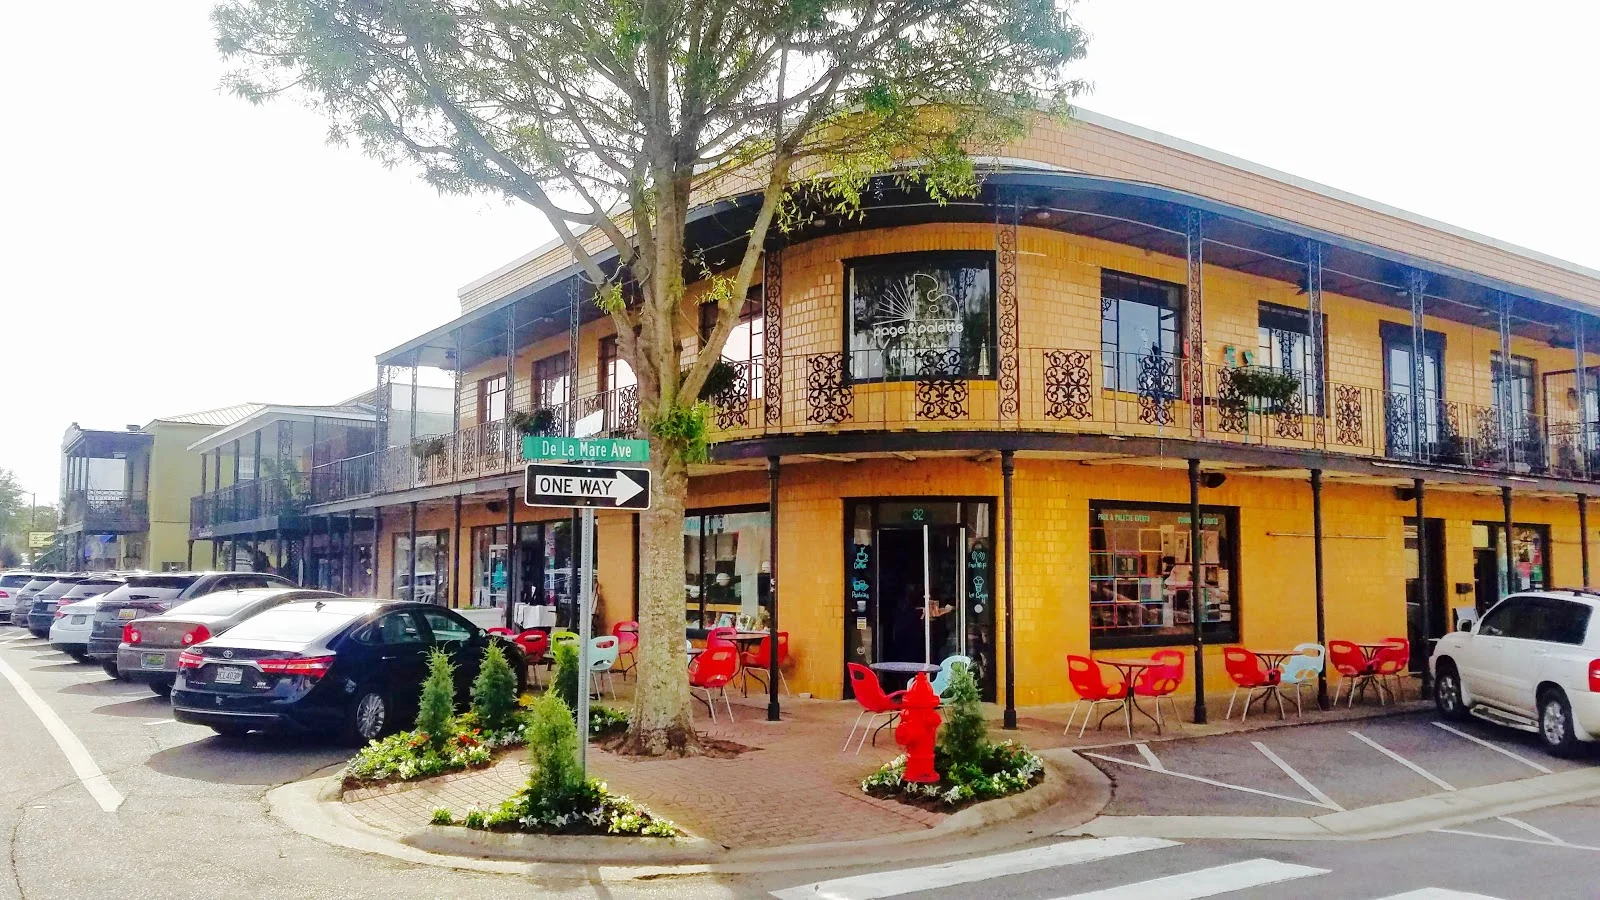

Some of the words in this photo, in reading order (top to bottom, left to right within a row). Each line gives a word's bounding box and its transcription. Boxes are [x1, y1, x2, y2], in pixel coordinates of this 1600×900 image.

[873, 325, 906, 340] page
[907, 322, 917, 335] &
[918, 321, 964, 337] palette
[542, 440, 557, 456] De
[561, 441, 575, 457] La
[580, 442, 607, 457] Mare
[611, 442, 632, 457] Ave
[540, 477, 573, 494] ONE
[580, 479, 613, 495] WAY
[912, 508, 924, 520] 32
